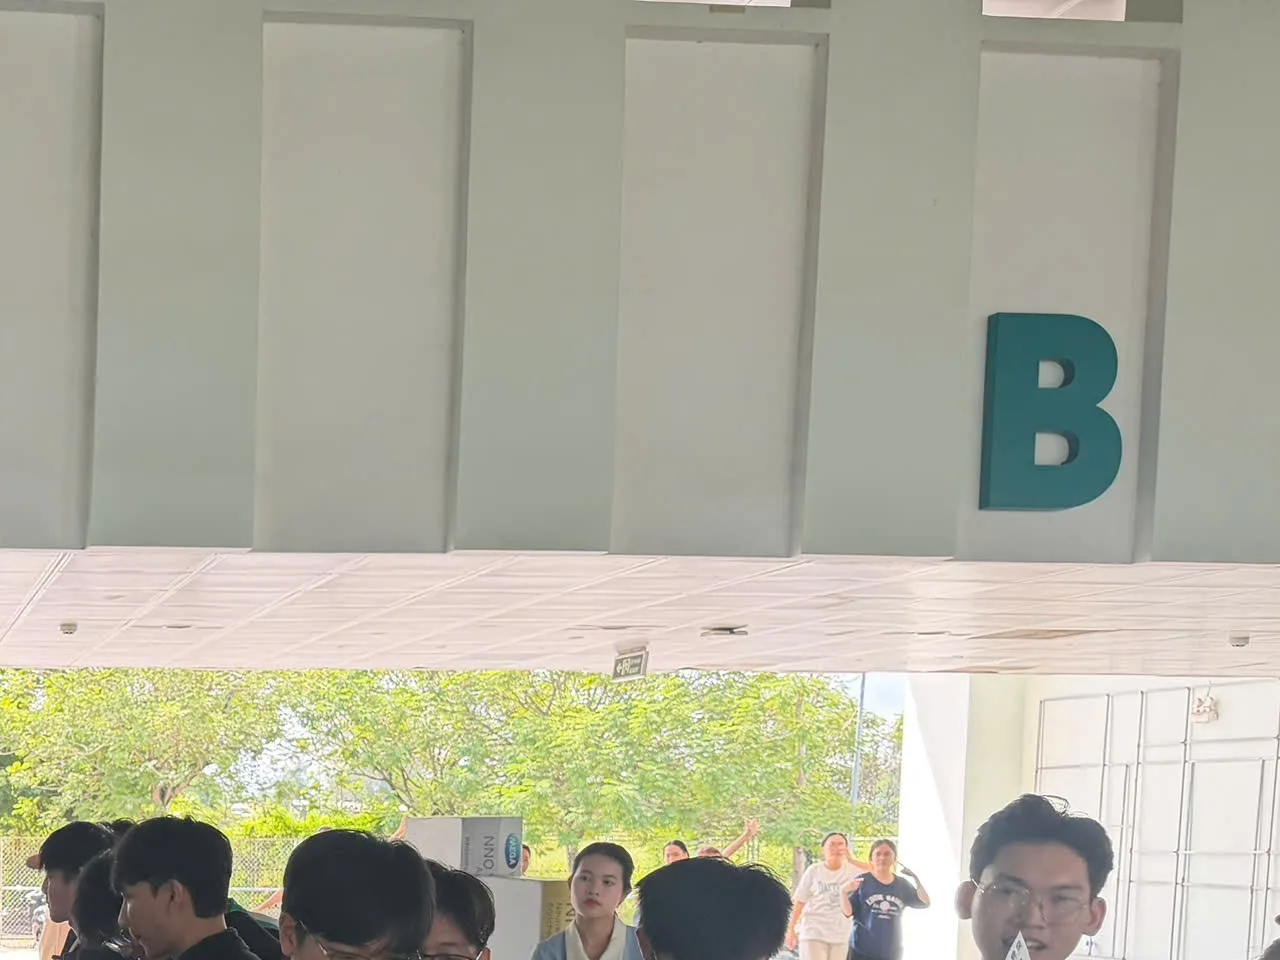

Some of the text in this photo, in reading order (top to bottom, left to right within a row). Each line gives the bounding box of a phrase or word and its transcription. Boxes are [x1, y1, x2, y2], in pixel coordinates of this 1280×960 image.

[979, 312, 1123, 511] B
[483, 836, 494, 870] NNO
[508, 836, 517, 866] MEGA
